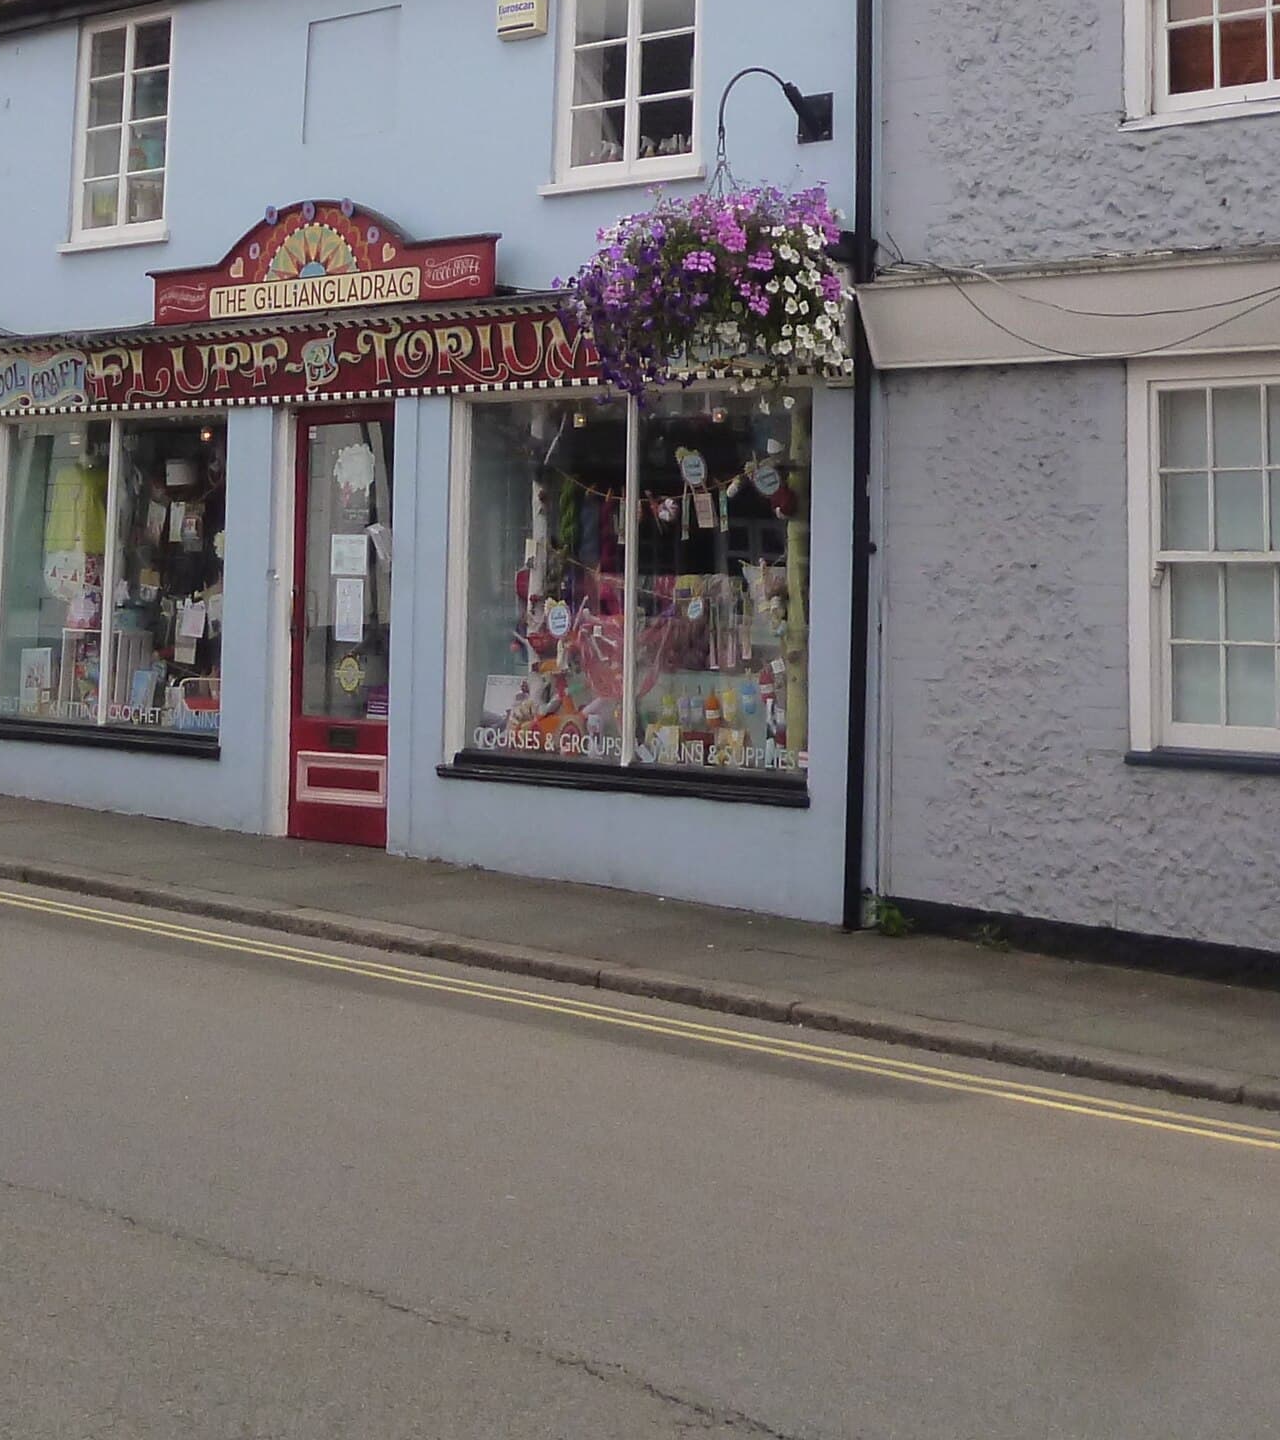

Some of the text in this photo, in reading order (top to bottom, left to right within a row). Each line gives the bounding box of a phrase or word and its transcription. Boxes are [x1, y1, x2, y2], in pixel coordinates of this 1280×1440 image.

[216, 287, 247, 314] THE
[31, 358, 83, 399] CRAFT
[108, 705, 162, 724] CROCHET
[473, 726, 622, 756] COURSES & GROUPS
[708, 744, 719, 765] &
[723, 746, 796, 770] SUPPLIES
